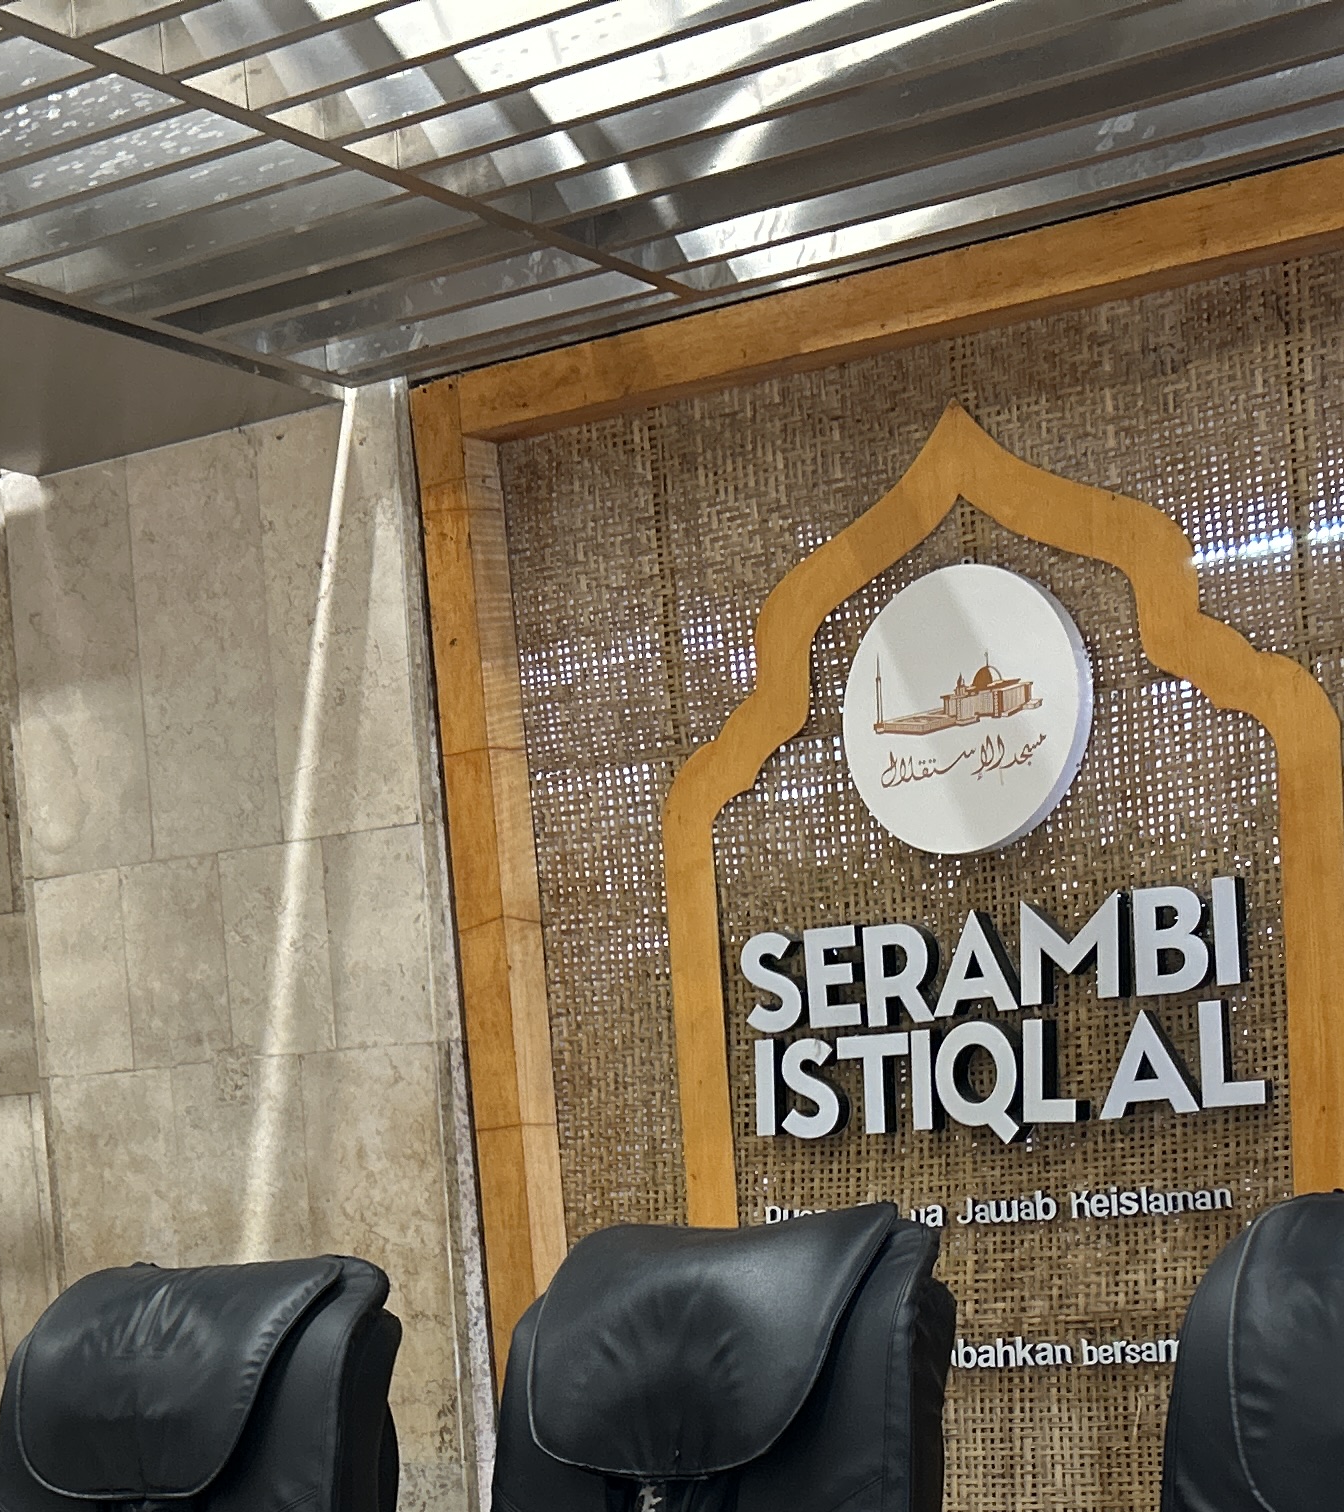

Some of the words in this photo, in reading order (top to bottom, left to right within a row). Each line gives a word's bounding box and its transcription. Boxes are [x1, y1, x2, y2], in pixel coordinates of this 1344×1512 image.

[739, 875, 1244, 1034] SERAMBI
[956, 1190, 1057, 1226] Jawab
[1070, 1186, 1235, 1219] Keislaman
[951, 1336, 1072, 1369] bahkan
